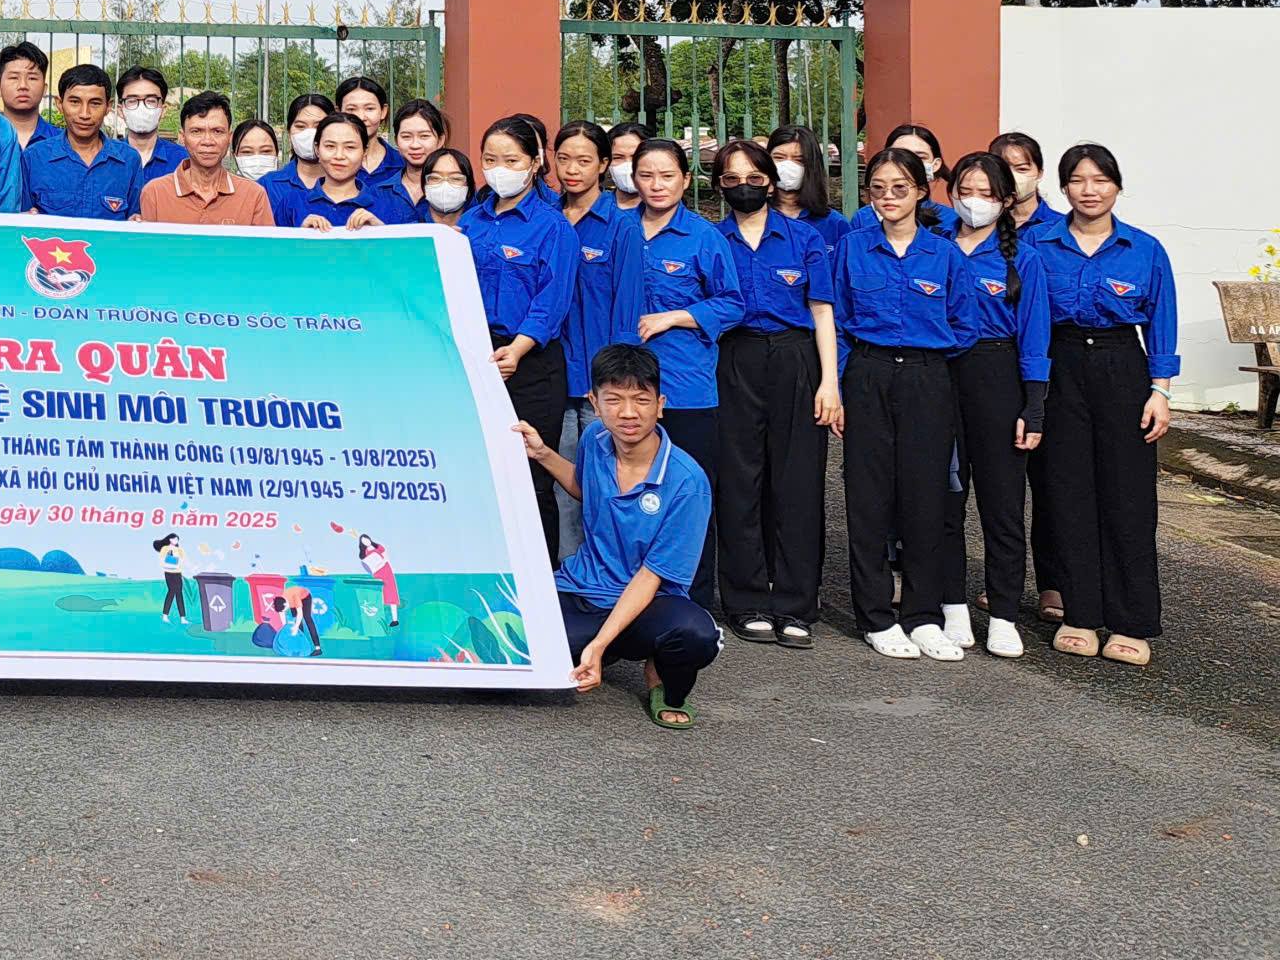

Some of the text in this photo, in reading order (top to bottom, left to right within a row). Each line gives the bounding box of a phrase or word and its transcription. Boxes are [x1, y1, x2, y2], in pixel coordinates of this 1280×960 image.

[34, 304, 90, 321] ĐOÀN
[96, 306, 179, 324] TRƯỜNG
[184, 311, 241, 327] CĐCĐ
[246, 313, 288, 330] SÓC
[293, 313, 363, 331] TRĂNG
[77, 337, 227, 384] QUÂN
[21, 389, 107, 423] SINH
[117, 390, 188, 425] MÔI
[197, 393, 343, 431] TRƯỜNG
[1, 433, 61, 458] THÁNG
[65, 436, 105, 460] TÁM
[110, 439, 169, 462] THÀNH
[174, 441, 224, 464] CÔNG
[229, 446, 324, 467] (19/8/1945
[341, 449, 437, 470] 19/8/2025)
[27, 466, 57, 494] HỘI
[63, 466, 100, 492] CHỦ
[105, 471, 163, 494] NGHĨA
[166, 472, 206, 499] VIỆT
[210, 477, 253, 498] NAM
[258, 478, 344, 500] (2/9/1945
[361, 481, 448, 503] 2/9/2025)
[47, 505, 74, 522] 30
[80, 507, 144, 528] tháng
[151, 509, 164, 525] 8
[171, 510, 218, 527] năm
[226, 511, 278, 528] 2025
